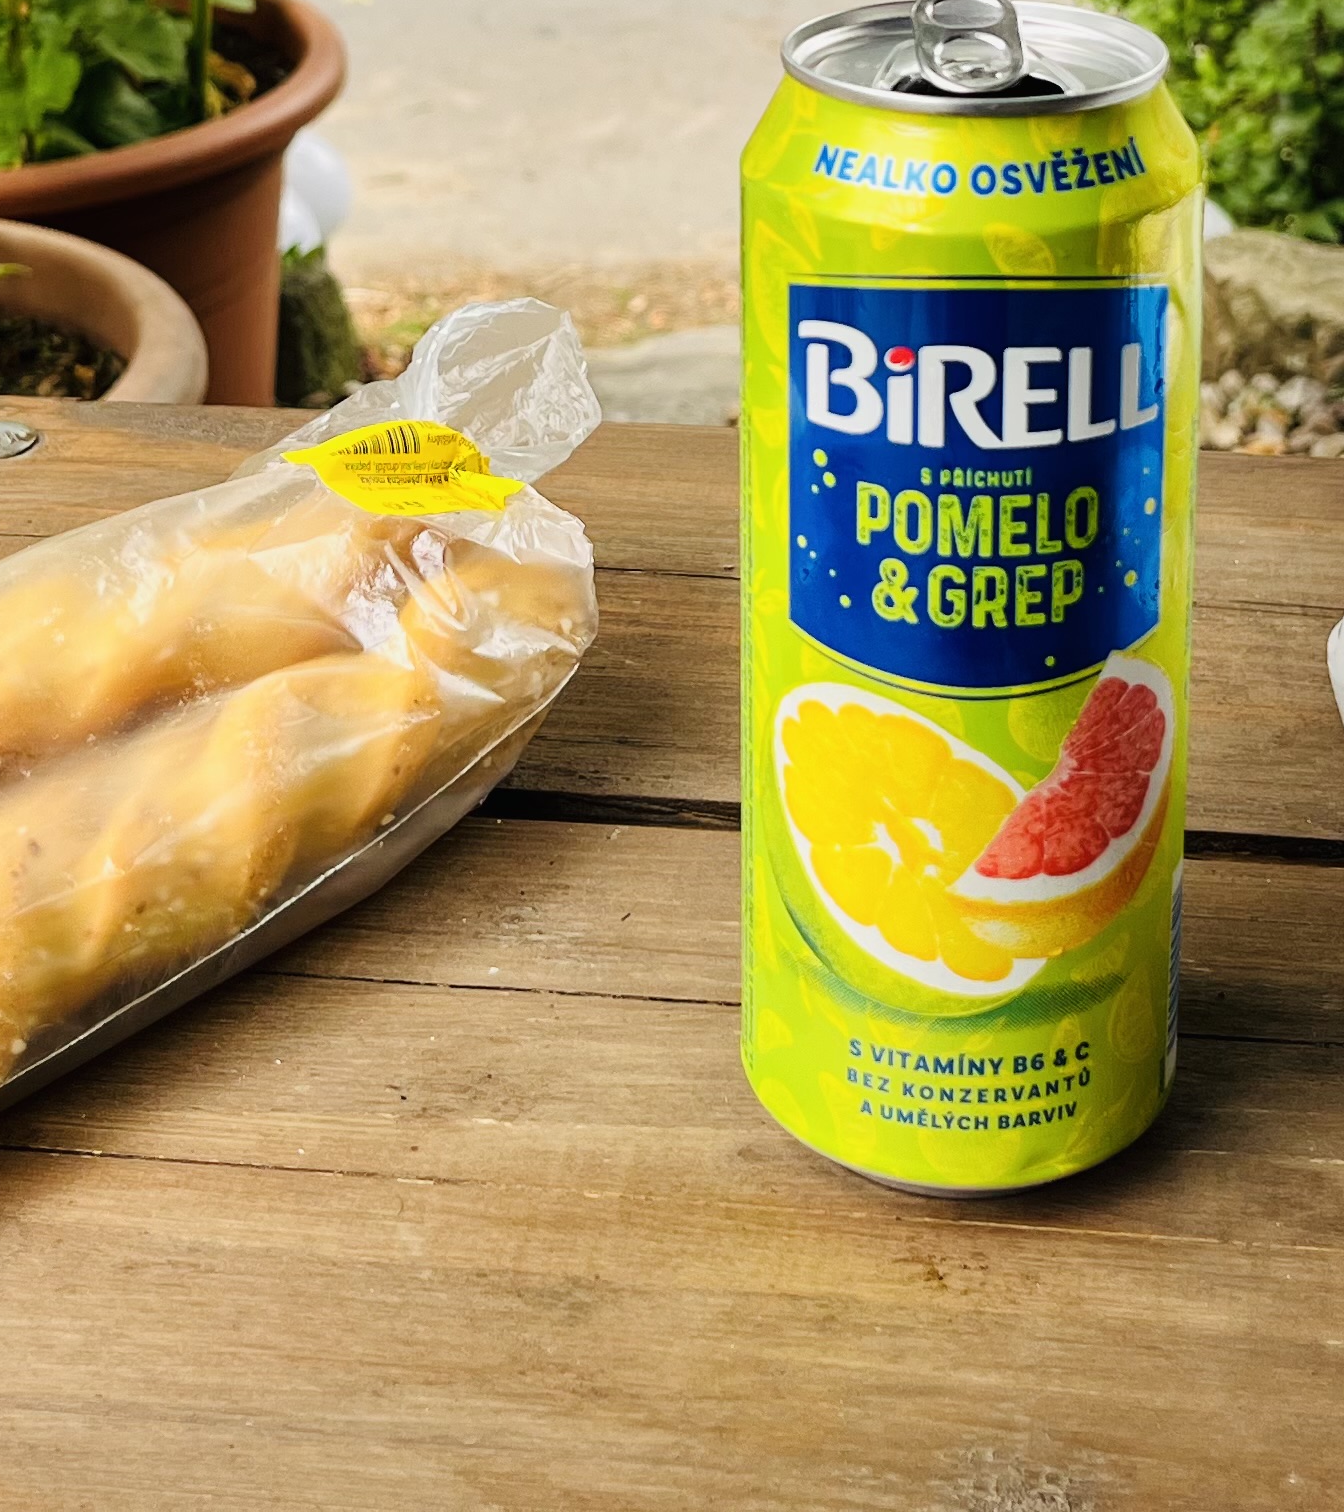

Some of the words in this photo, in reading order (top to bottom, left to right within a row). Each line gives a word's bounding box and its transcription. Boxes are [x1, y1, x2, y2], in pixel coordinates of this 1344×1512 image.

[814, 144, 957, 194] NEALKO
[970, 136, 1146, 196] OSVĚŽENÍ
[920, 466, 933, 486] S
[856, 481, 1099, 558] POMELO
[849, 1038, 862, 1057] S
[870, 1043, 1004, 1076] VITAMÍNY
[1013, 1053, 1045, 1075] B6
[1053, 1048, 1068, 1067] &
[1075, 1041, 1090, 1061] C
[847, 1067, 890, 1093] BEZ
[902, 1066, 1091, 1104] KONZERVANTŮ
[860, 1100, 873, 1115] A
[879, 1104, 989, 1130] UMĚLÝCH
[998, 1101, 1078, 1130] BARVIV
